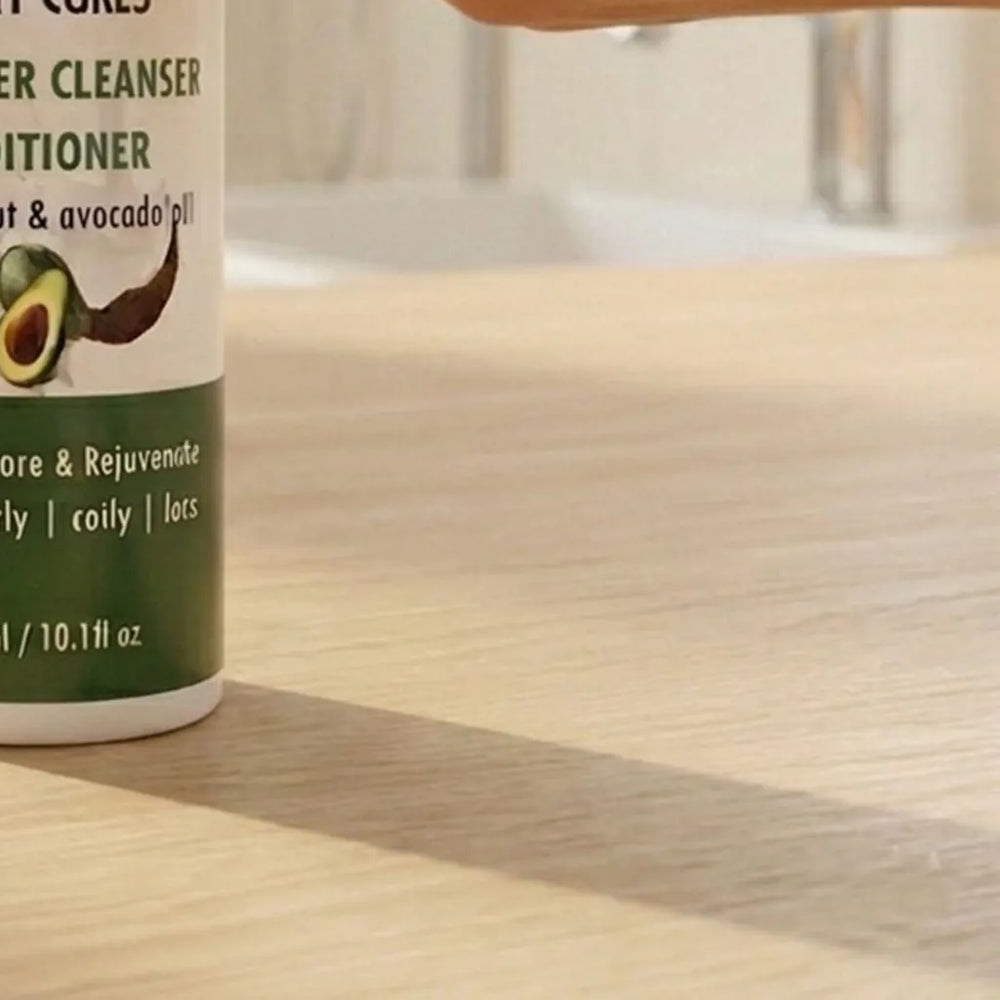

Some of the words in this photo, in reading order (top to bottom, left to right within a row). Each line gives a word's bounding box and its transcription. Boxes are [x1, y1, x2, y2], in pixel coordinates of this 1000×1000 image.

[51, 56, 201, 100] CLEANSER
[28, 199, 48, 230] &
[61, 195, 163, 229] avocado
[55, 448, 74, 478] &
[84, 440, 200, 482] Rejuvenate
[72, 495, 132, 537] coily
[18, 622, 32, 659] /
[118, 624, 143, 648] oz
